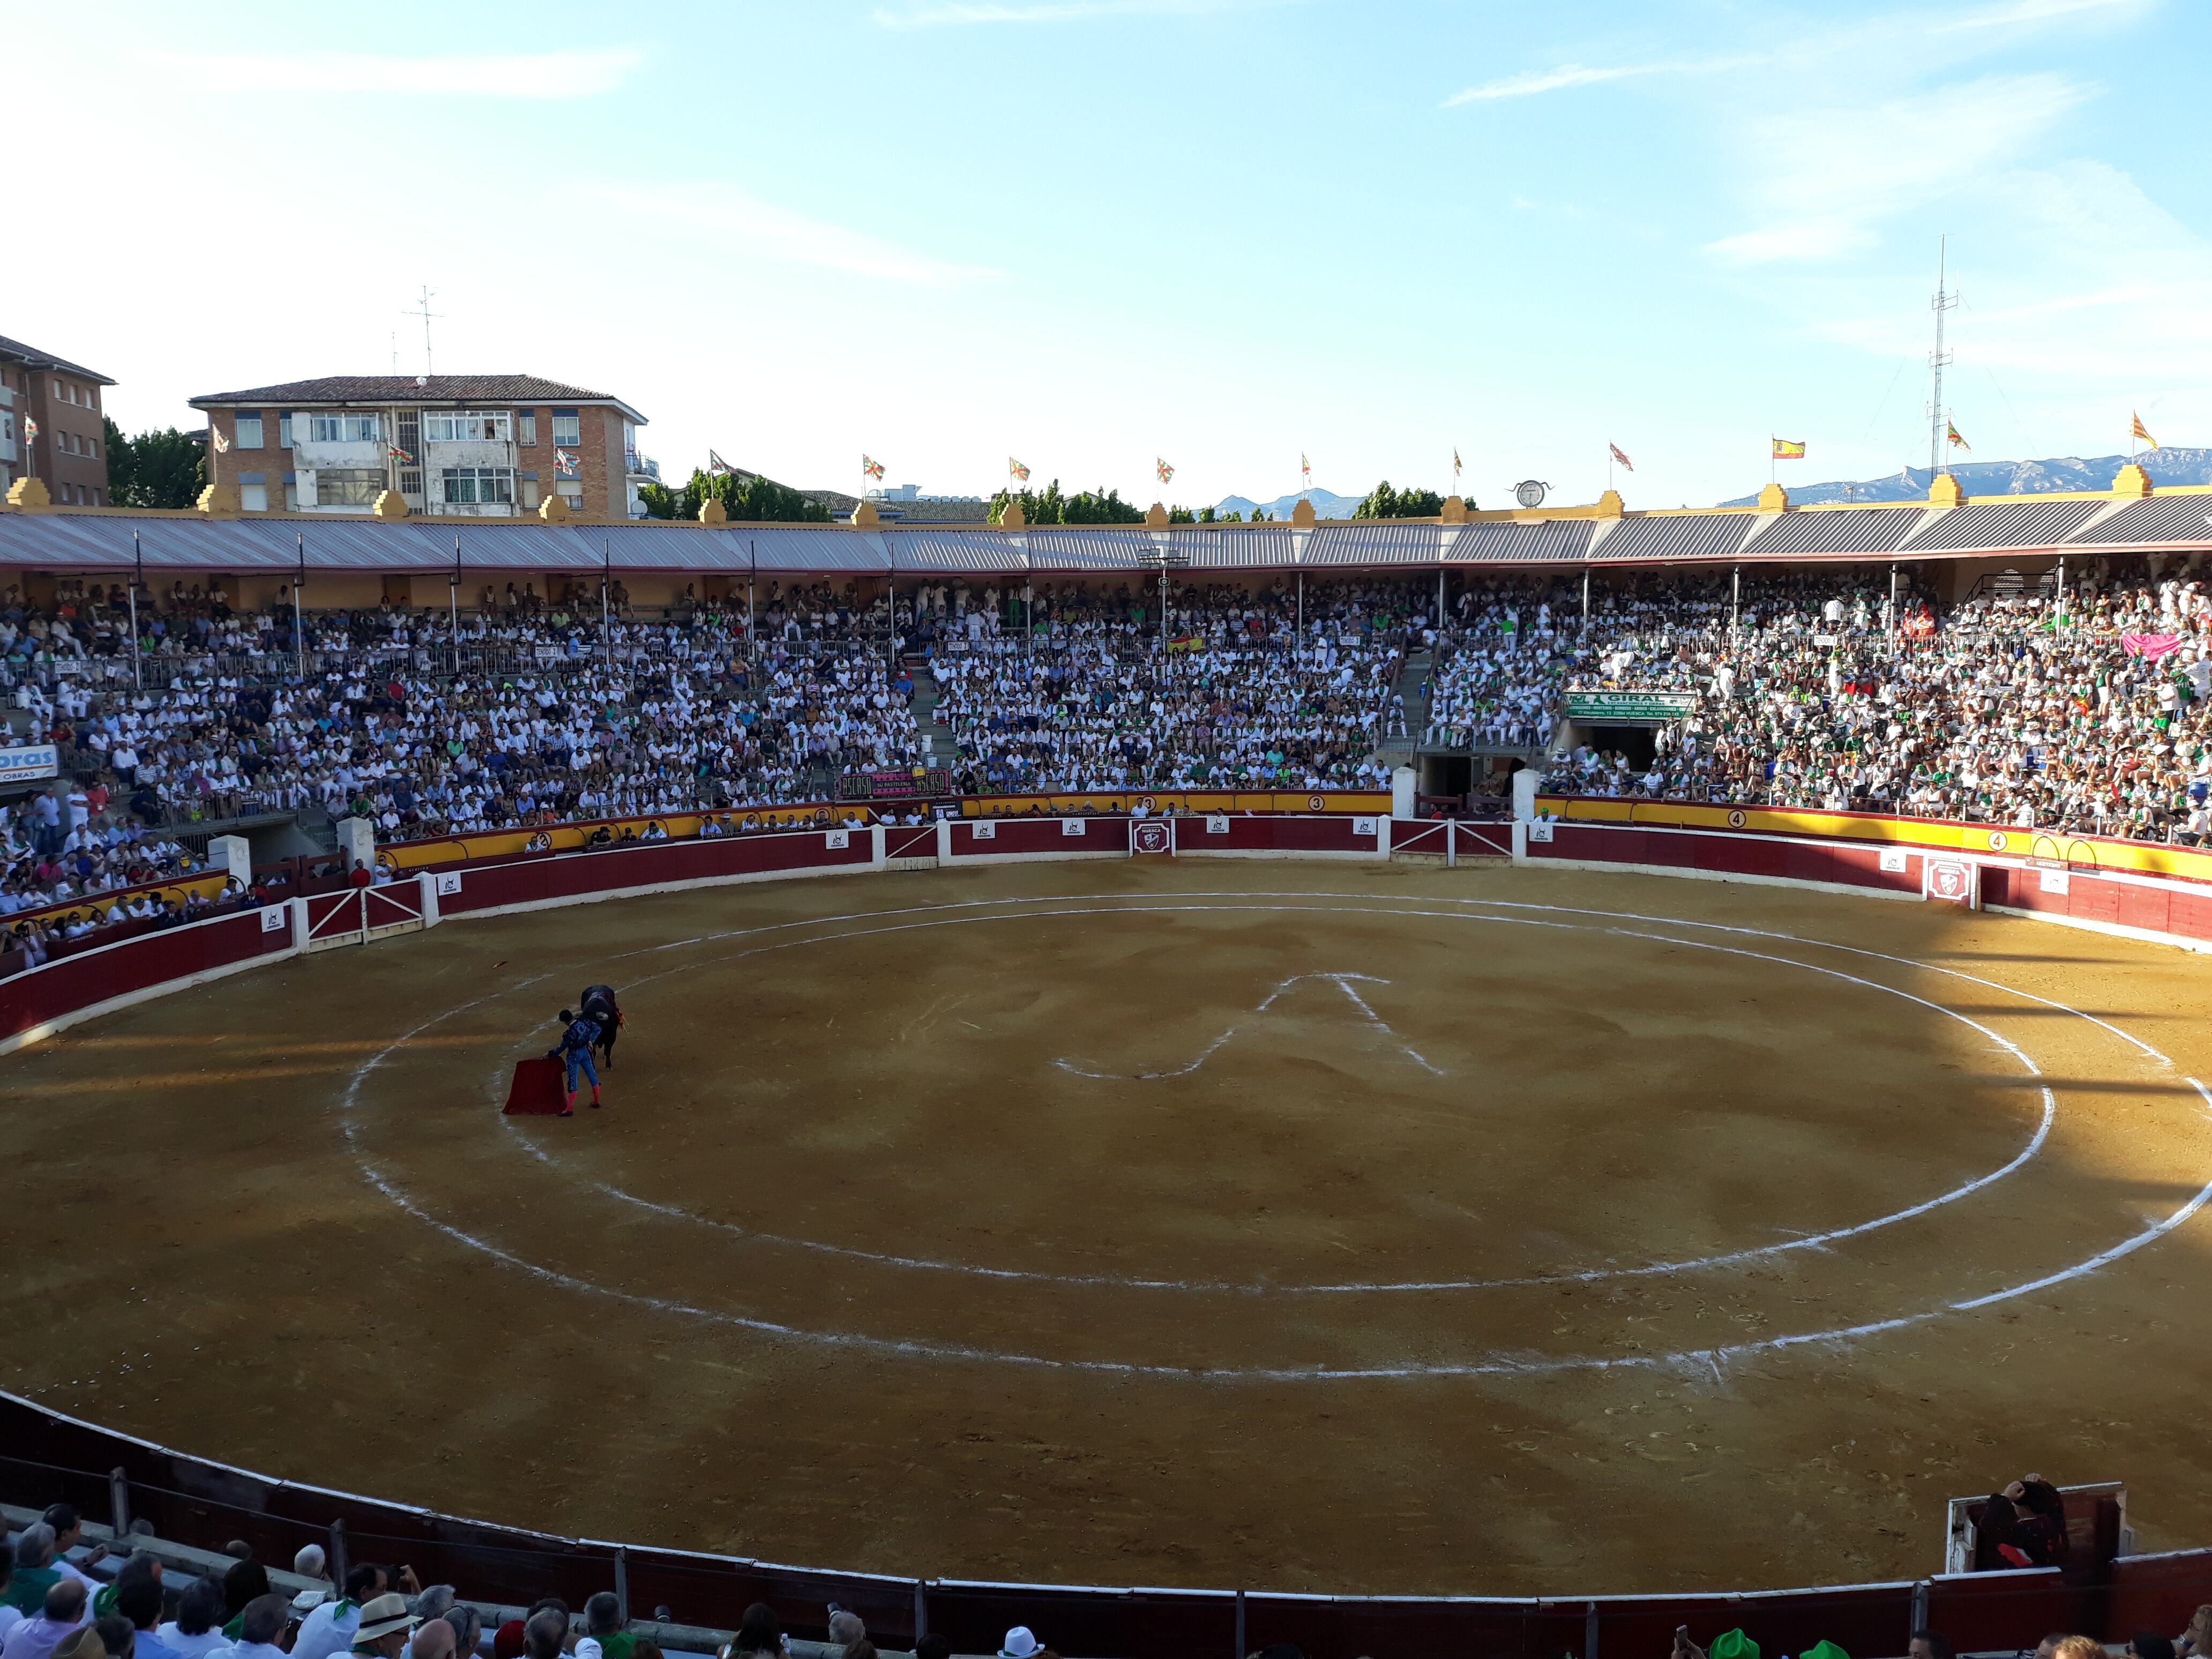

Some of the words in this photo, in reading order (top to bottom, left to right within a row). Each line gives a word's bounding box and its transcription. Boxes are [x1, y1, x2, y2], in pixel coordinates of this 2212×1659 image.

[843, 776, 871, 795] ASCASO
[1145, 799, 1152, 809] 3
[1314, 798, 1320, 808] 3
[1732, 813, 1740, 824] 4
[540, 834, 547, 846] 2
[1993, 835, 2000, 847] 4
